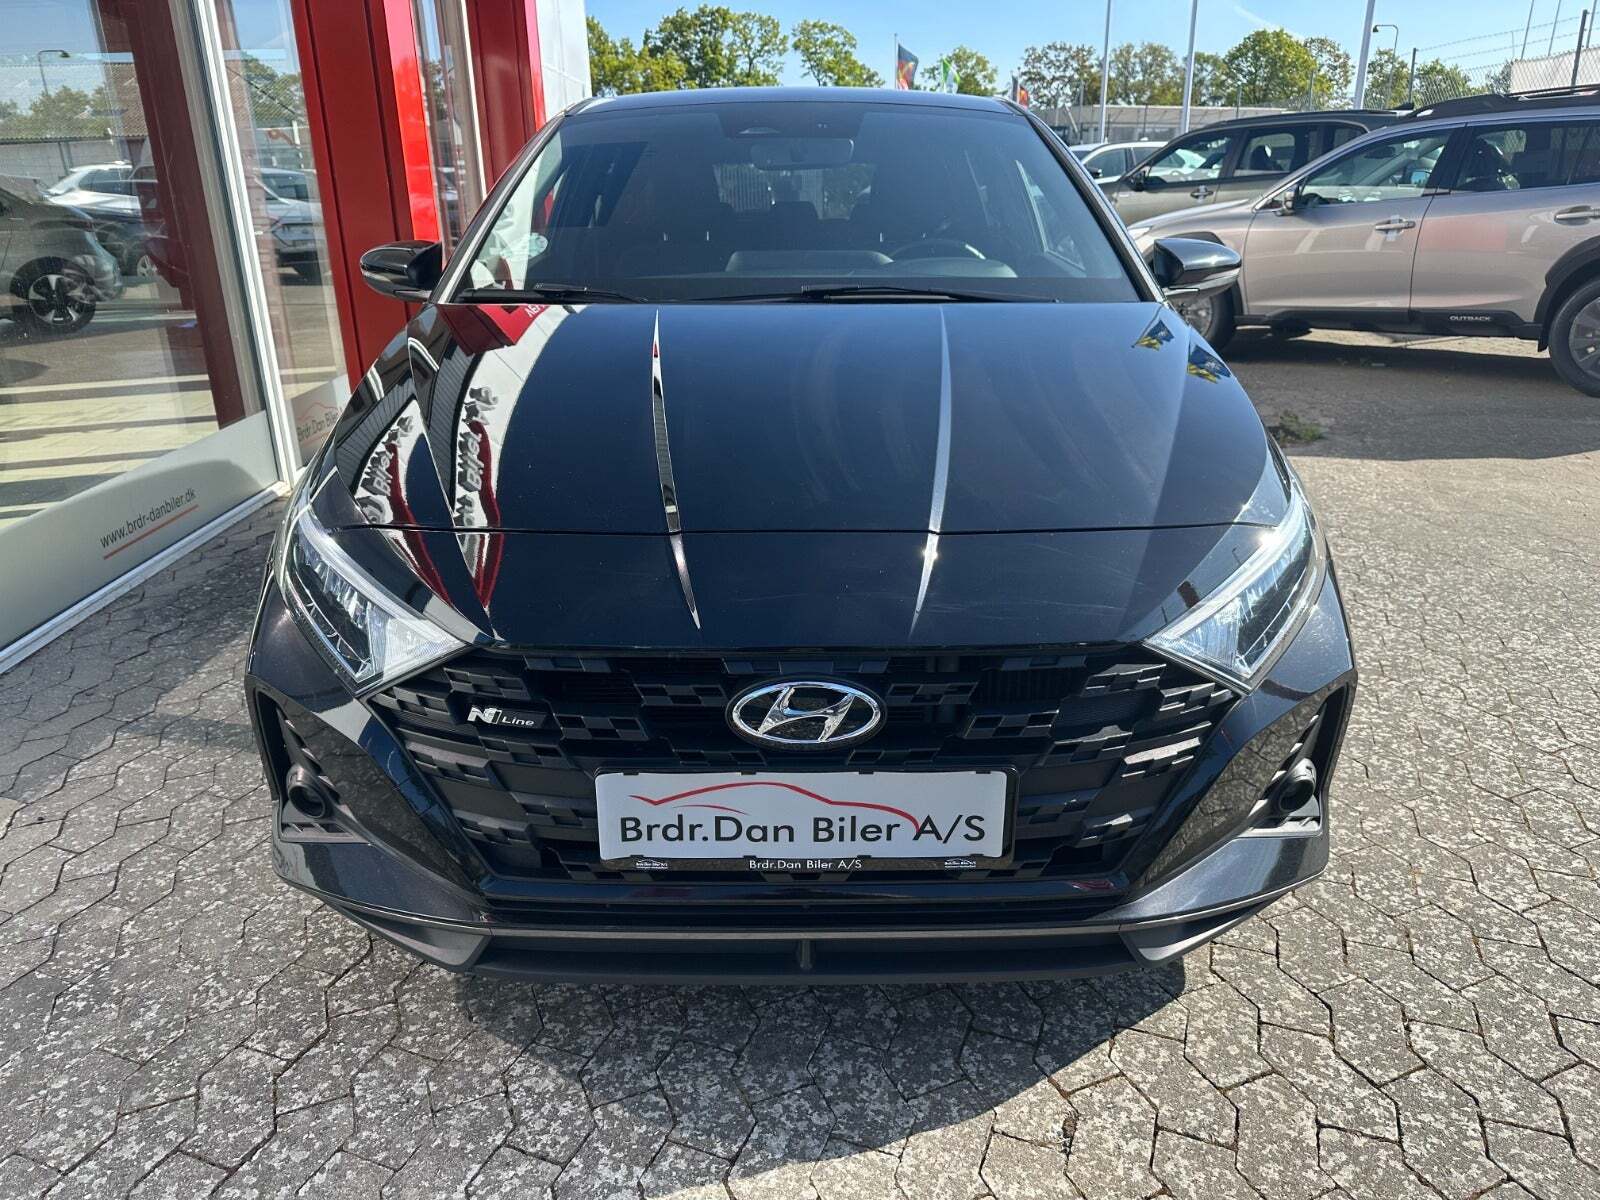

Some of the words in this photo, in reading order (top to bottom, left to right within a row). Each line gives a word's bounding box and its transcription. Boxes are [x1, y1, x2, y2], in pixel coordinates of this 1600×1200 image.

[100, 487, 197, 549] www.brdr-danbiler.dk
[502, 716, 535, 726] Line
[620, 814, 795, 843] Brdr.Dan
[813, 815, 901, 843] Biler
[912, 814, 986, 844] A/S
[749, 859, 801, 869] Brdr.Dan
[806, 859, 833, 869] Biler
[838, 858, 862, 869] A/S
